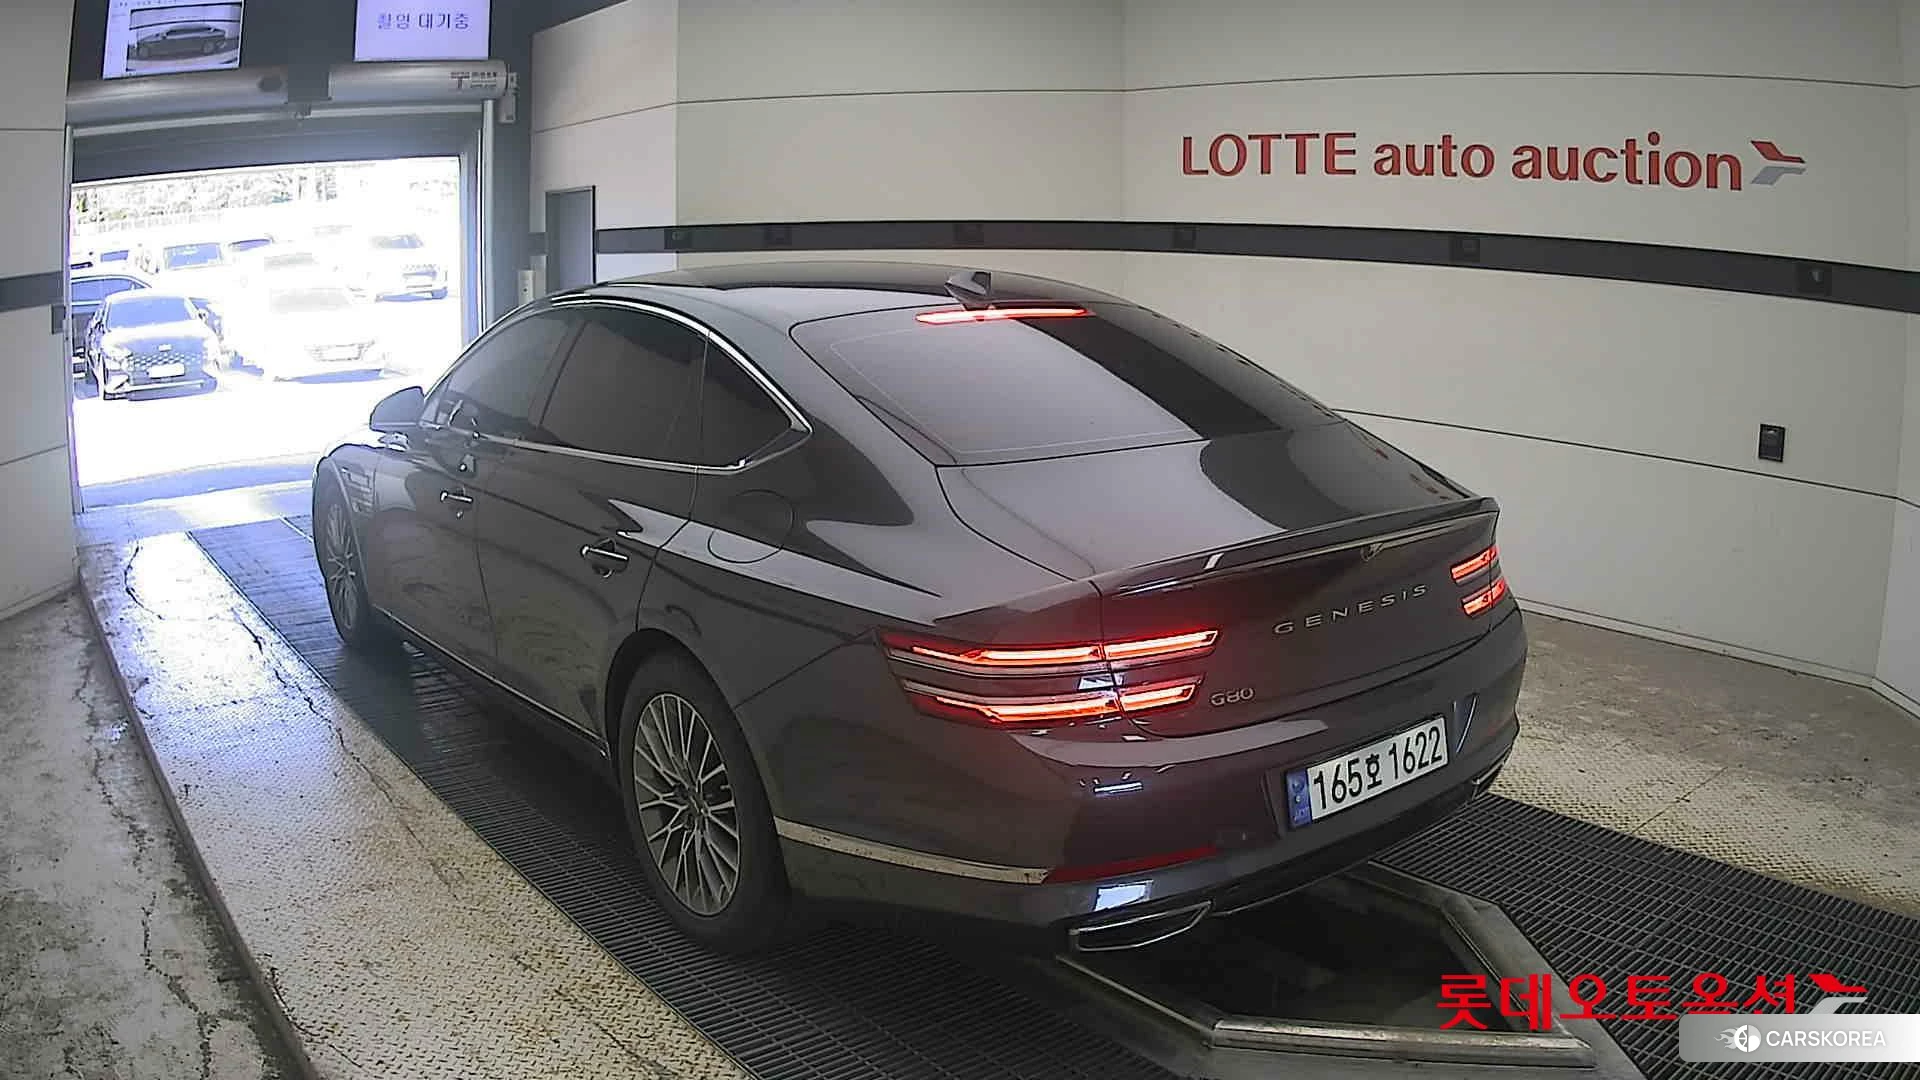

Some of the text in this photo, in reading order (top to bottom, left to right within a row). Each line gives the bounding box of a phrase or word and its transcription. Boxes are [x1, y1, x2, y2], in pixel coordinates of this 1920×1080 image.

[418, 12, 469, 30] 대기중
[1183, 131, 1743, 190] LOTTE auto auction
[1273, 584, 1427, 635] GENESIS
[1210, 687, 1255, 707] G80
